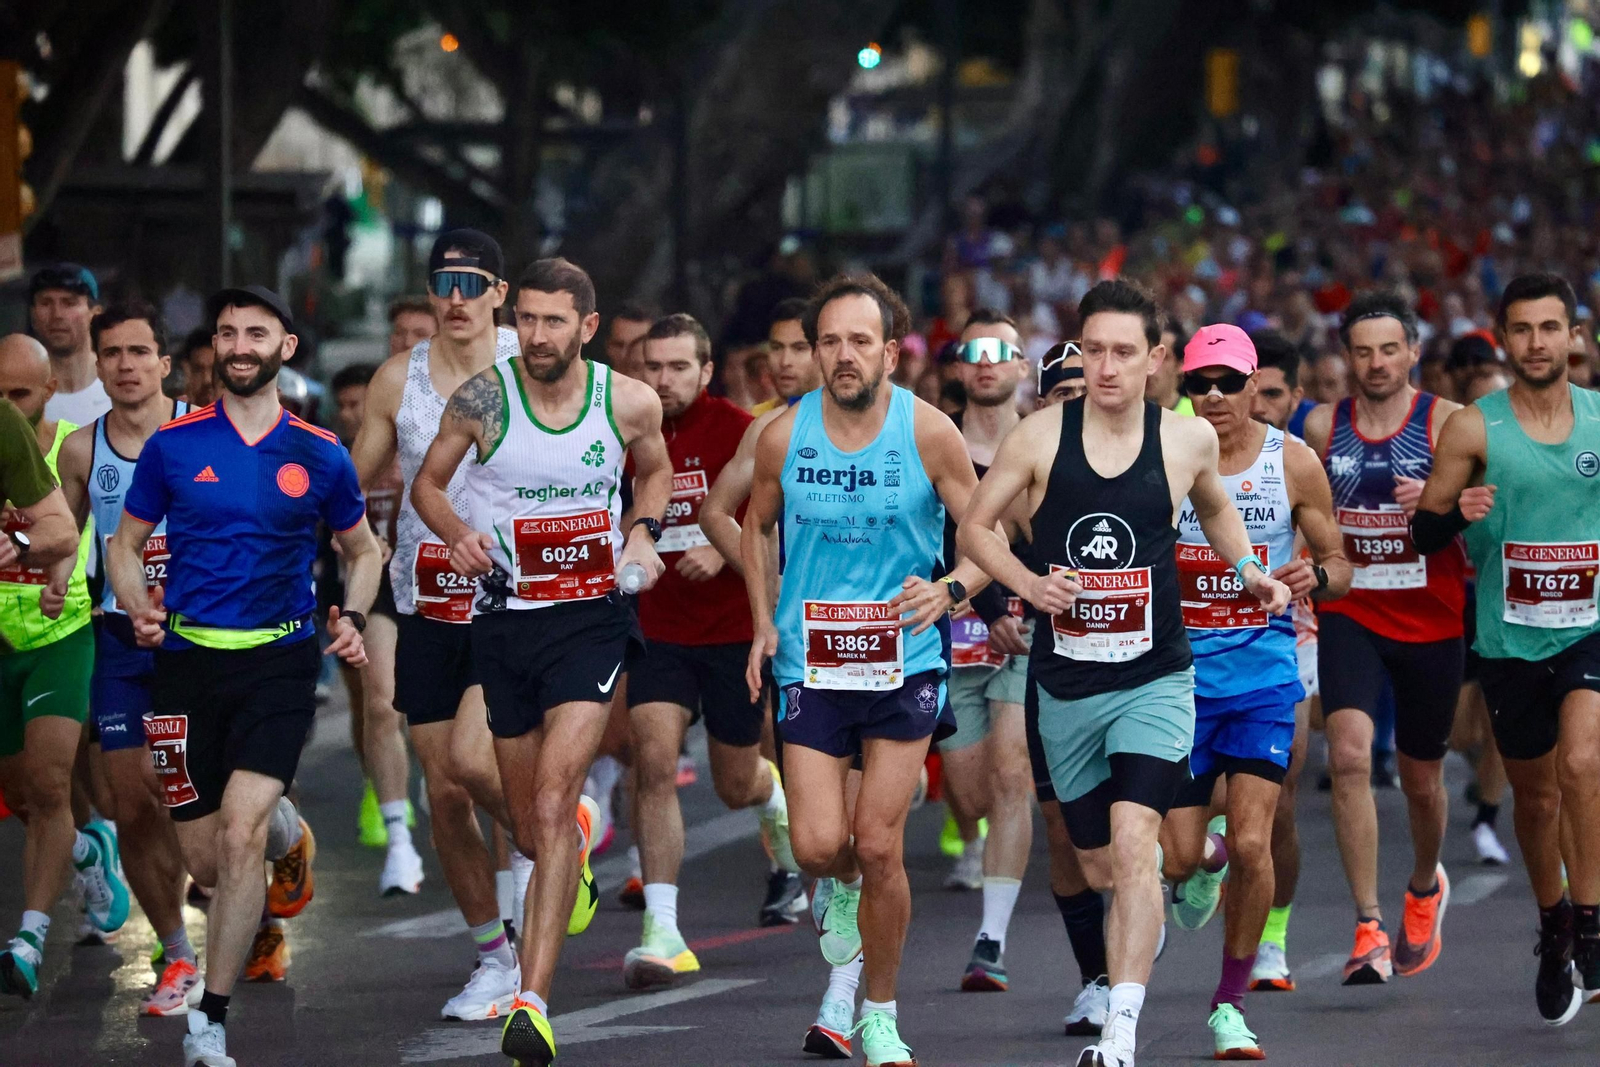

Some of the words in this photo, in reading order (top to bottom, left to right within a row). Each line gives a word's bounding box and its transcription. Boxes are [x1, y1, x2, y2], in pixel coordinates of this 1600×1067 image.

[594, 381, 604, 408] soar
[673, 476, 700, 491] RALI
[796, 464, 877, 493] nerja
[514, 484, 578, 503] Togher
[805, 491, 865, 504] ATLETISMO
[1236, 492, 1262, 503] mayfo
[665, 502, 693, 517] 509
[541, 513, 606, 534] GENERALI
[1356, 513, 1408, 527] GENERA
[541, 544, 590, 563] 6024
[1080, 534, 1119, 561] AR
[1353, 538, 1405, 555] 13399
[1529, 546, 1594, 560] GENERALI
[145, 563, 168, 579] 92
[1196, 575, 1244, 592] 6168
[1523, 573, 1580, 590] 17672
[828, 606, 888, 619] GENERAL
[1070, 603, 1129, 621] 15057
[823, 634, 881, 651] 13862
[837, 652, 859, 660] MAREK
[143, 720, 182, 735] NERALI
[151, 749, 168, 767] 73
